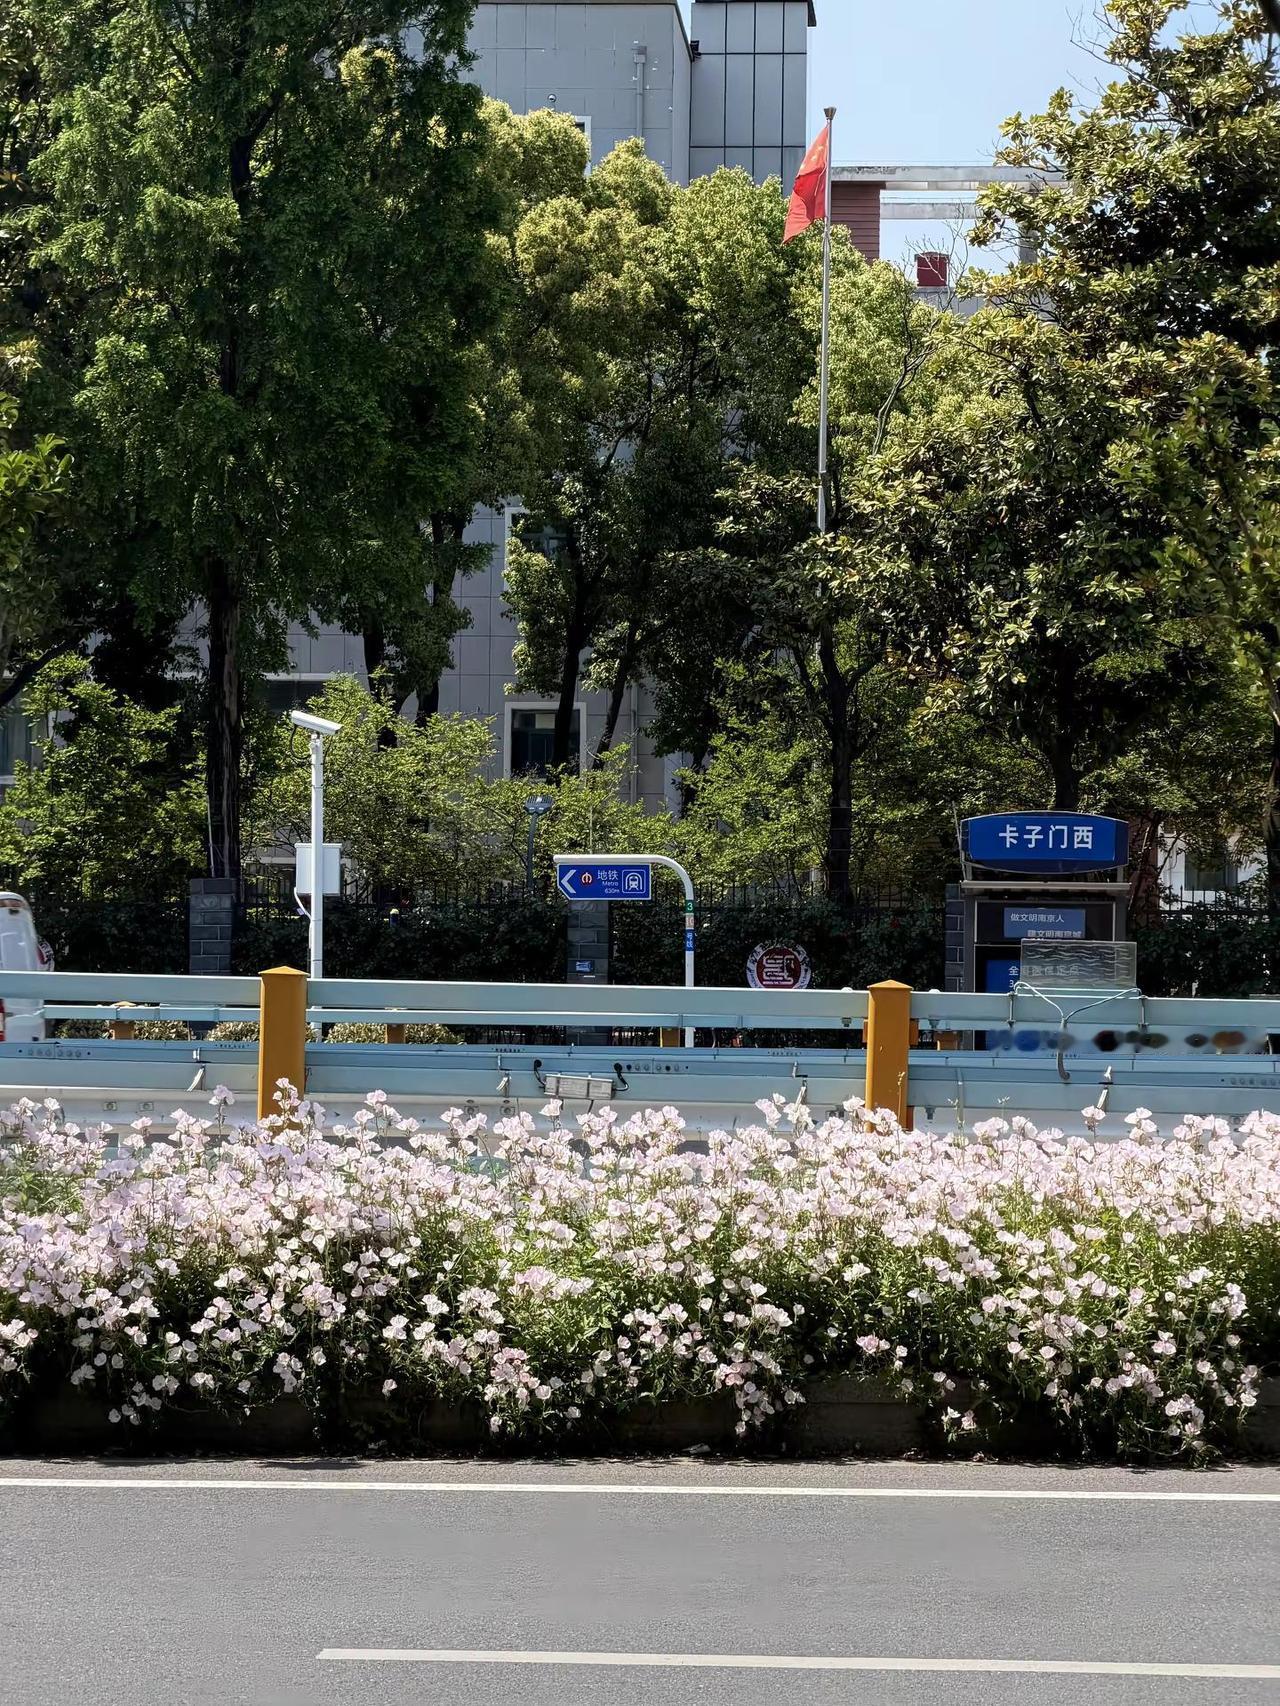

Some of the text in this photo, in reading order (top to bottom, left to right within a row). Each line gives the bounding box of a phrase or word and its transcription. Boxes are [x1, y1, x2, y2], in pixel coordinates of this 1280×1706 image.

[998, 824, 1094, 849] 卡子门西
[596, 870, 619, 880] 地铁
[687, 902, 694, 911] 3
[1010, 913, 1065, 923] 做文明南京人
